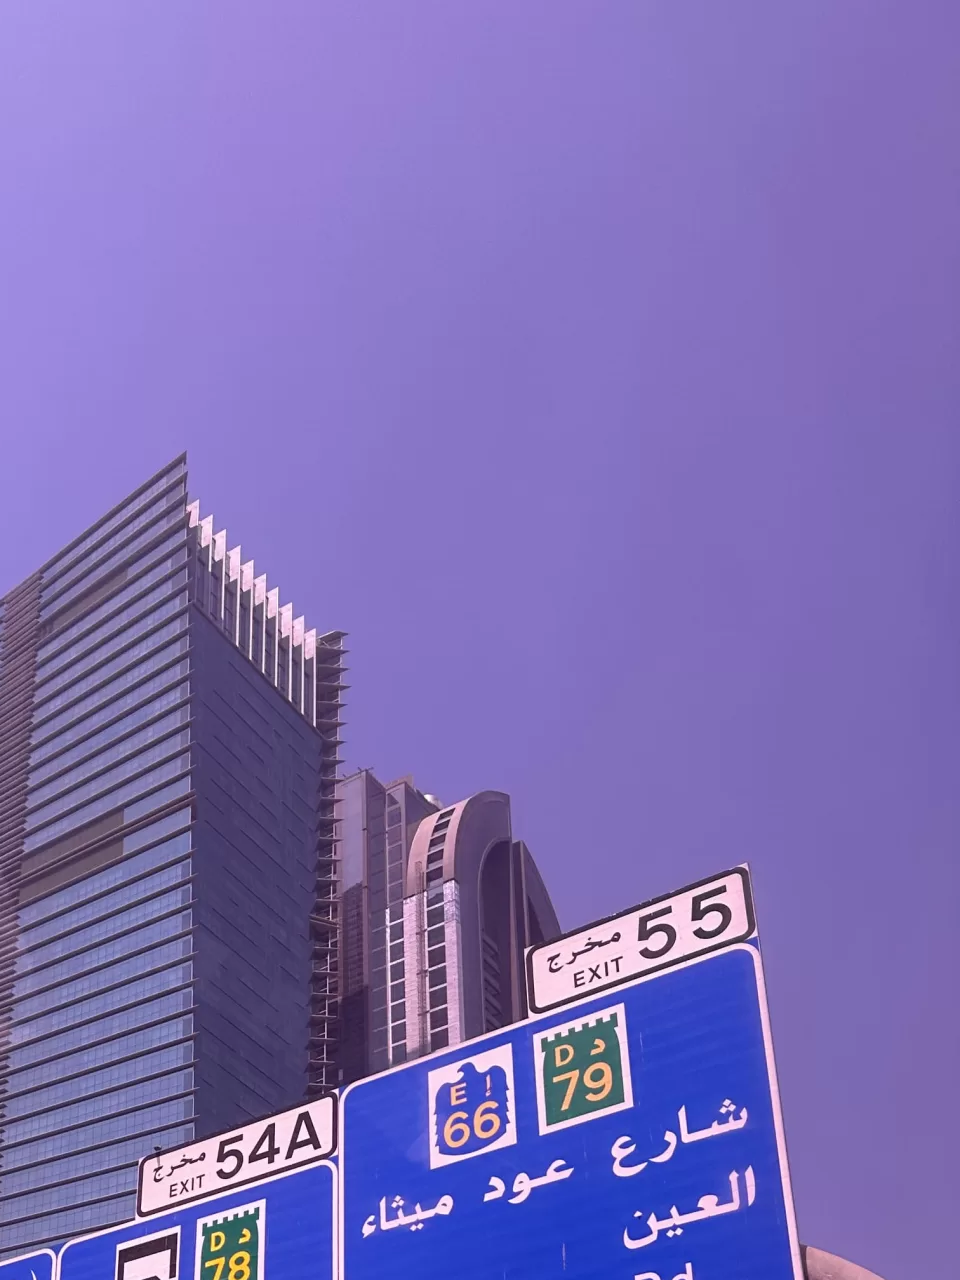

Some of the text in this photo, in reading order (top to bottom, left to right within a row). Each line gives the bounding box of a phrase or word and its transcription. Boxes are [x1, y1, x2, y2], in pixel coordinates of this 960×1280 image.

[639, 884, 734, 960] 55
[547, 929, 622, 973] مخرج
[573, 955, 625, 989] EXIT
[554, 1043, 574, 1068] D
[589, 1036, 607, 1056] د
[450, 1083, 467, 1106] E
[552, 1060, 614, 1112] 79
[443, 1101, 501, 1149] 66
[215, 1110, 322, 1180] 54A
[152, 1151, 207, 1183] مخرج
[360, 1098, 748, 1240] شارع عود ميثاء
[168, 1174, 206, 1199] EXIT
[623, 1164, 757, 1250] العين
[210, 1230, 221, 1252] D
[238, 1226, 251, 1245] د
